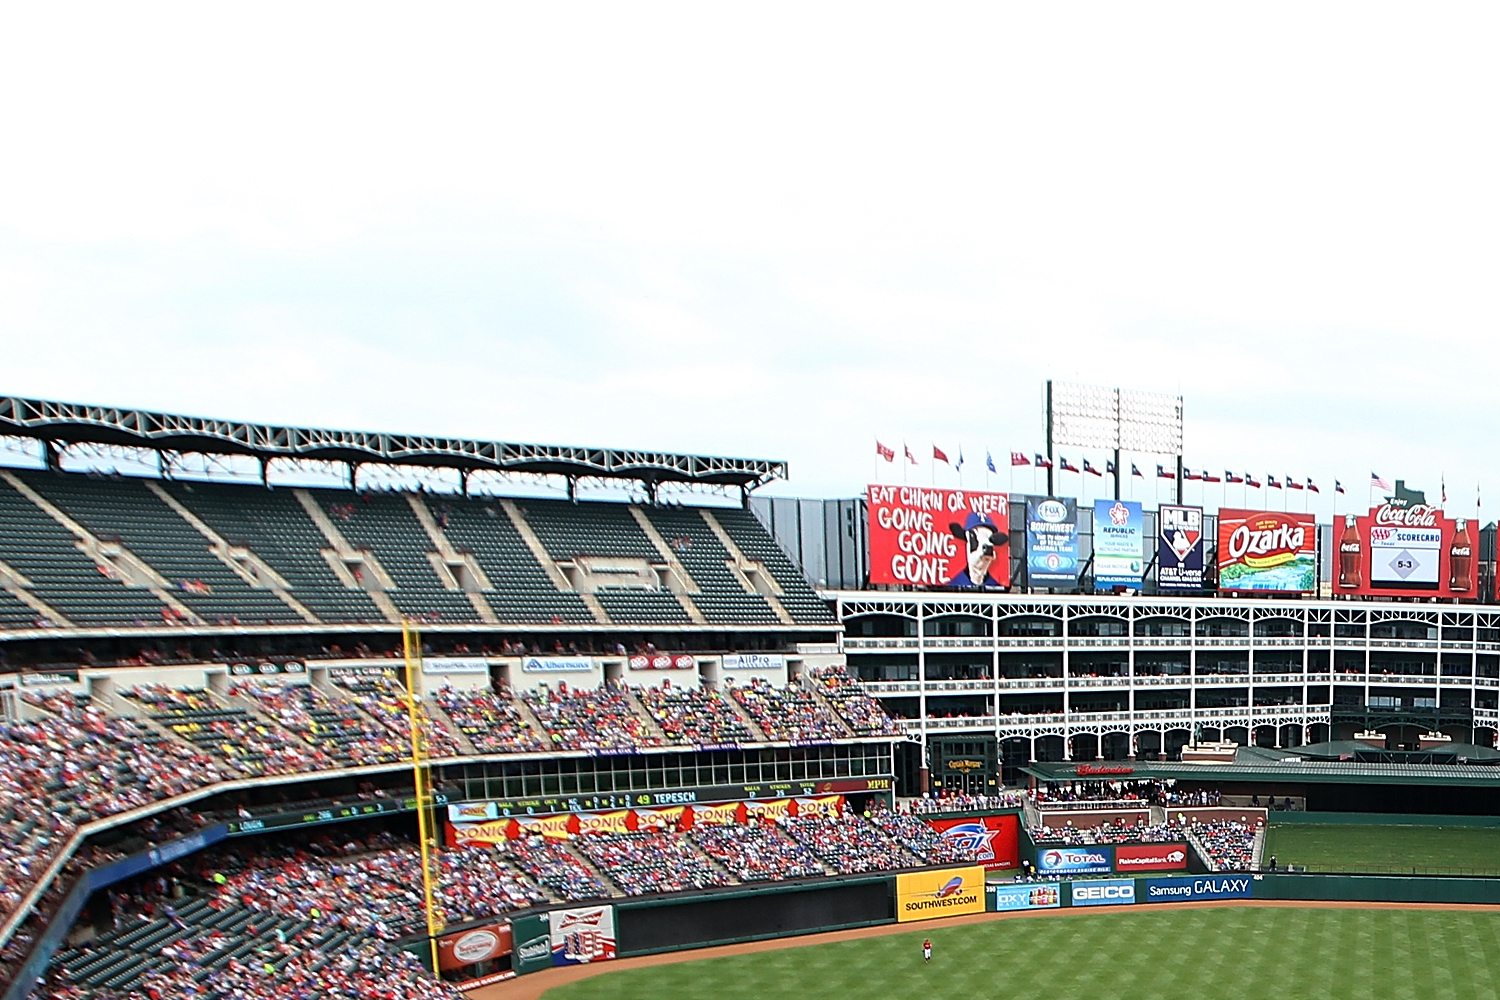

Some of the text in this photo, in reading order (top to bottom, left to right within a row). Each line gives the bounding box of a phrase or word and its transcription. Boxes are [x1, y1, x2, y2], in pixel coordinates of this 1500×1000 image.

[870, 486, 1007, 516] EAT CHIKIN OR WEER
[1390, 498, 1408, 507] Enjoy
[1044, 505, 1060, 513] FOX
[878, 507, 933, 532] GOING
[1164, 509, 1200, 526] MLB
[1030, 521, 1075, 533] SOUTHWEST
[898, 530, 957, 557] GOING
[1229, 523, 1306, 558] Ozarka
[1397, 533, 1440, 542] SCORECARD
[891, 554, 951, 584] GONE
[1397, 560, 1412, 569] 5-3
[1160, 567, 1202, 577] AT&T U-verse
[738, 655, 769, 665] AllPro
[1074, 763, 1134, 776] Budweiser
[867, 779, 889, 790] MPH
[637, 792, 696, 804] 49 TEPESCH
[458, 807, 485, 817] SONIC
[693, 809, 738, 821] SONIC
[749, 806, 790, 818] SONIC
[520, 820, 567, 834] SONIC
[579, 817, 626, 830] SONIC
[455, 826, 507, 841] SONIC
[1066, 854, 1105, 863] TOTAL
[1072, 886, 1134, 900] GEICO
[1150, 879, 1250, 897] Samsung GALAXY
[906, 896, 977, 911] SOUTHWEST.COM
